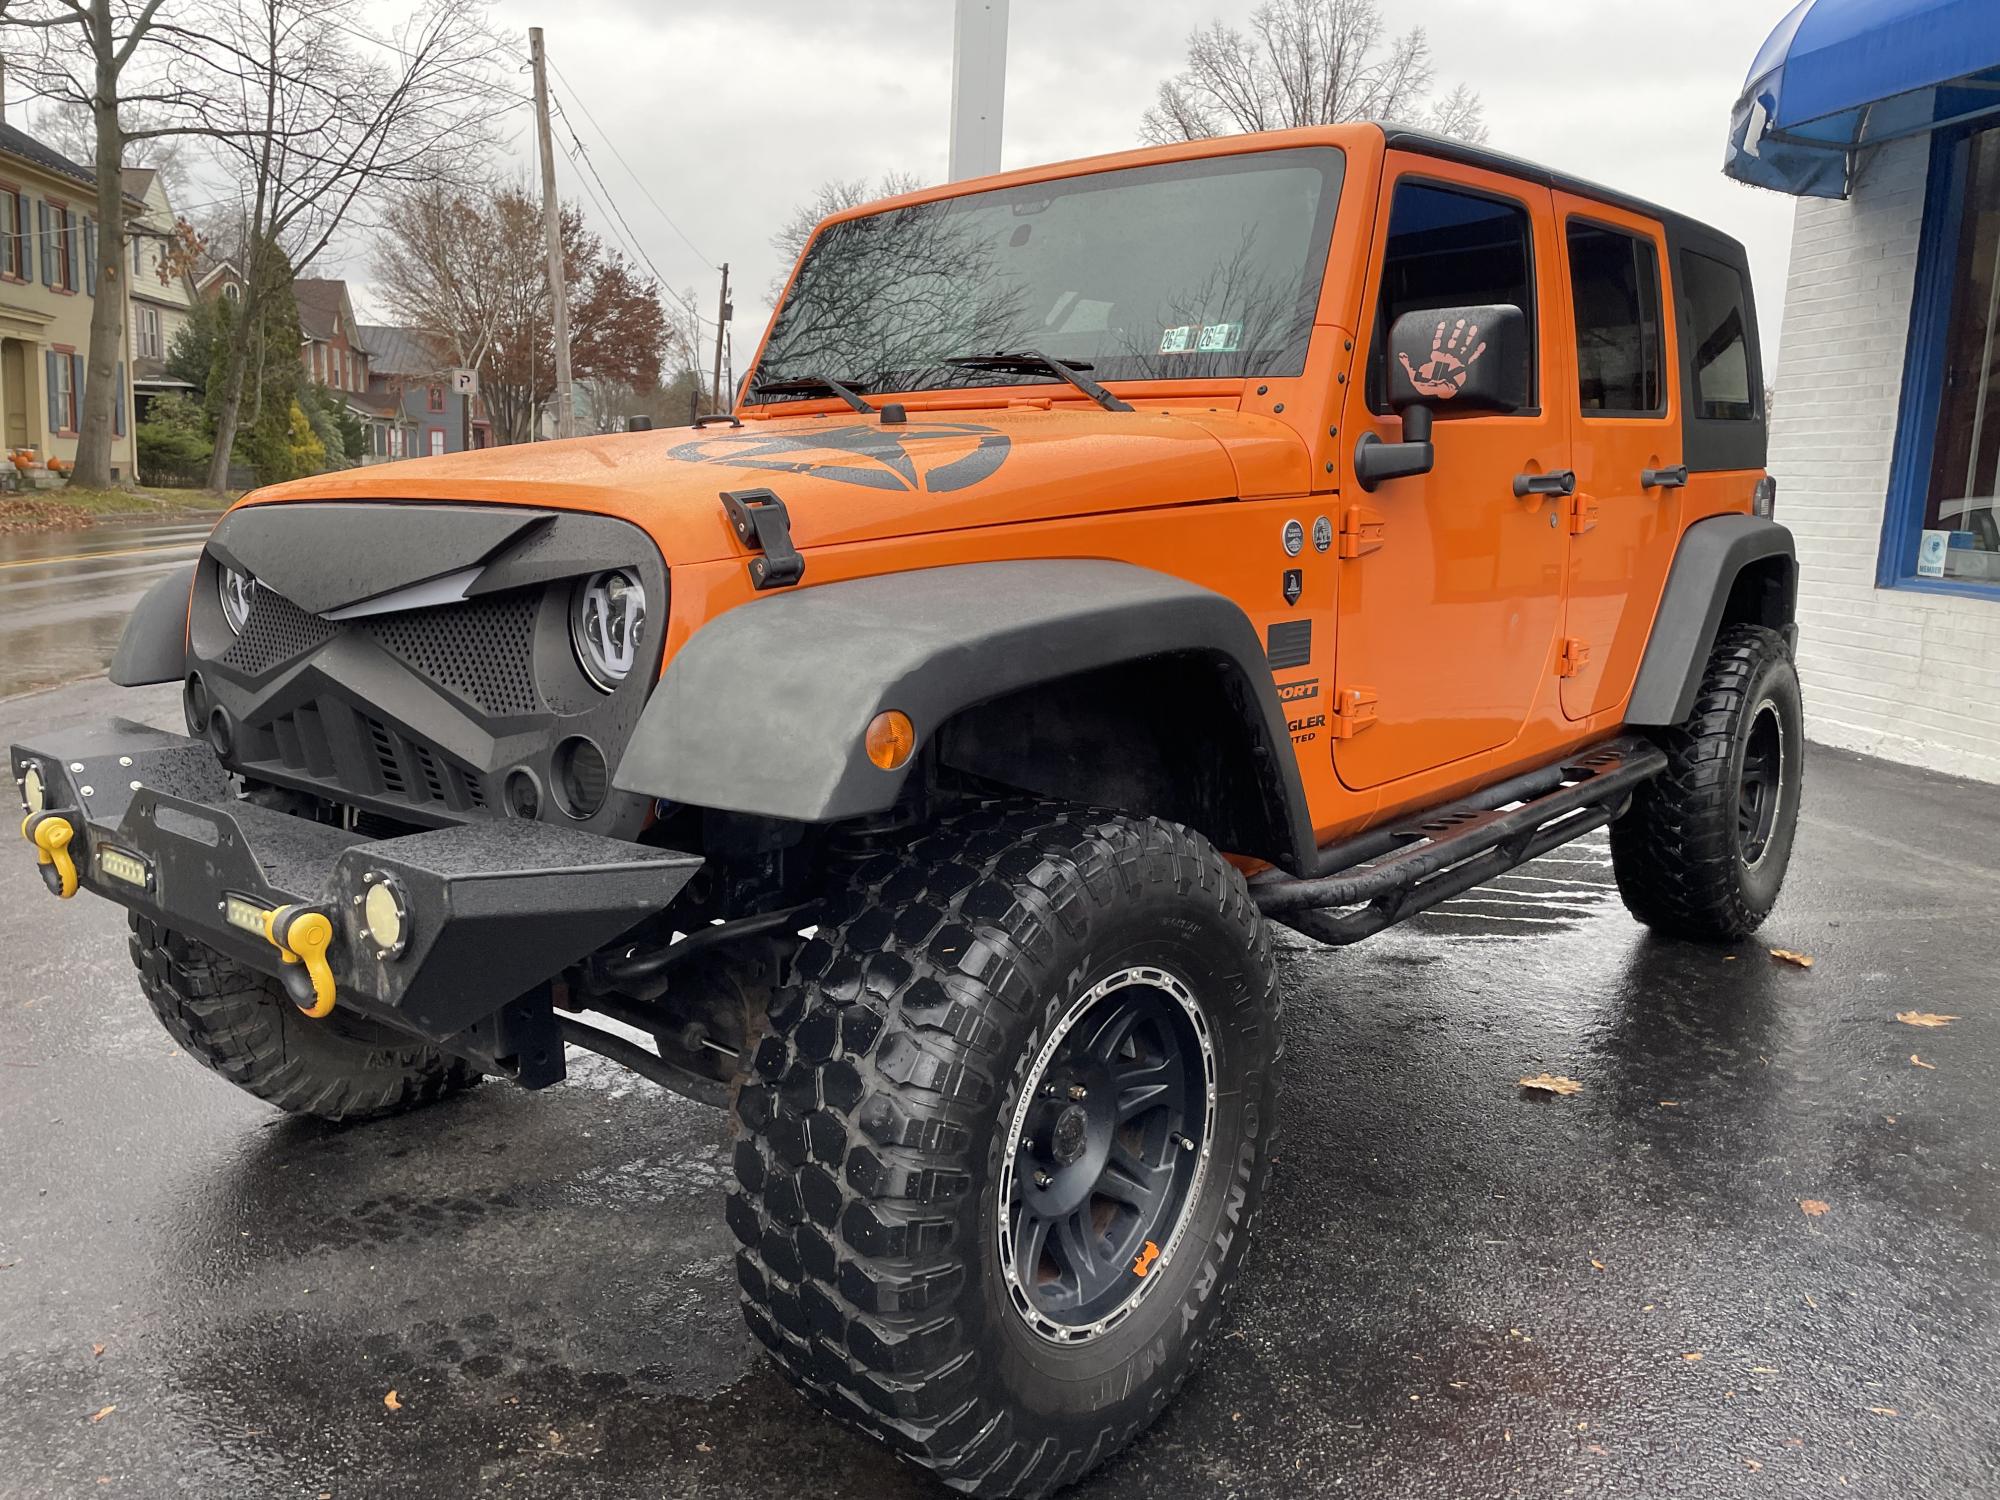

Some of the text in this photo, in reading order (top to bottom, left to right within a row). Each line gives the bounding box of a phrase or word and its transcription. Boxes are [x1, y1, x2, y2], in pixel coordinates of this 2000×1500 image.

[1162, 330, 1175, 350] 26
[1200, 327, 1214, 347] 26
[1413, 361, 1466, 391] JK
[1010, 1035, 1057, 1138] PRO COMP XTREME
